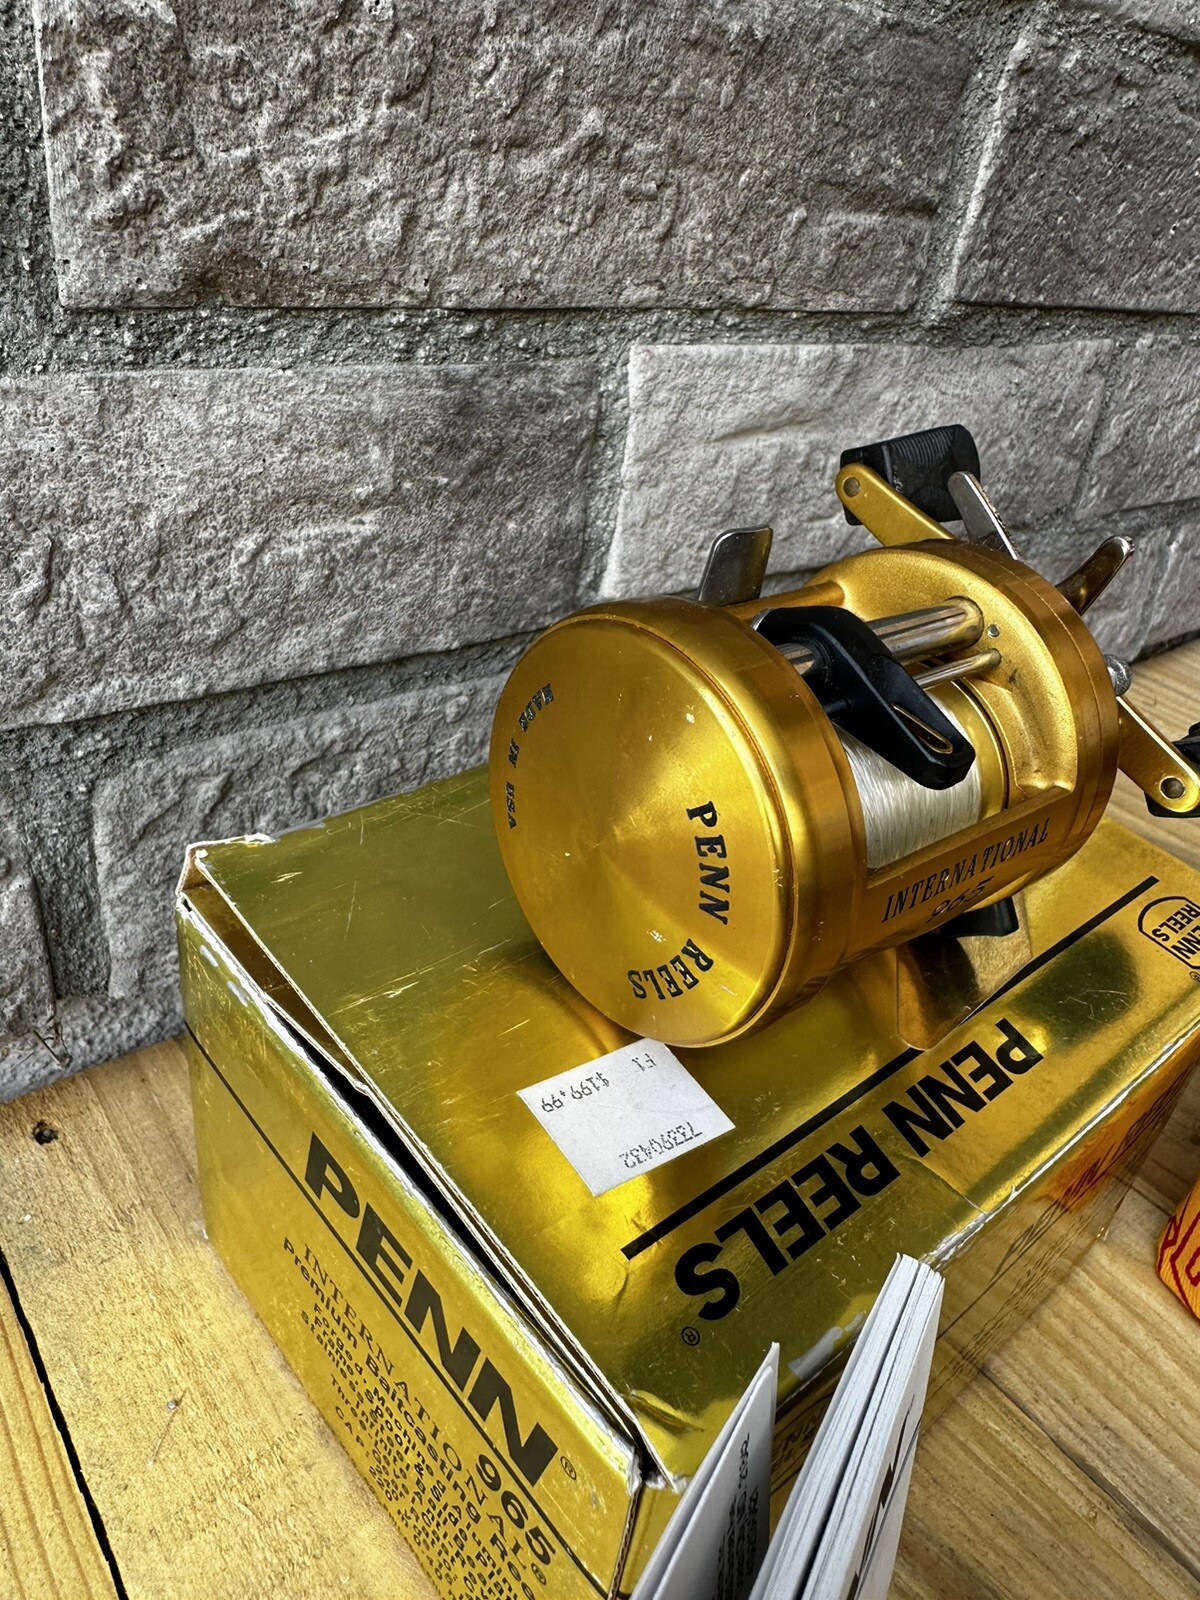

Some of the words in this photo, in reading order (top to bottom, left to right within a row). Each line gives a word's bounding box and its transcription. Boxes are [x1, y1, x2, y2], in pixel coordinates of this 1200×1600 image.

[508, 738, 520, 768] IN
[518, 683, 554, 732] MADE
[505, 781, 517, 829] USA
[686, 801, 730, 925] PENN
[881, 818, 1050, 923] INTERNATIONAL
[627, 938, 714, 1000] REELS
[1151, 904, 1200, 942] REELS
[541, 1071, 610, 1112] $199.99
[632, 1053, 657, 1072] F1
[881, 1017, 1044, 1158] PENN
[674, 1124, 901, 1321] REELS
[304, 1132, 559, 1487] PENN
[283, 1236, 358, 1349] Premium
[365, 1353, 481, 1526] Baitcasting
[300, 1309, 364, 1404] Stainless
[368, 1407, 410, 1472] Steel
[414, 1476, 448, 1527] Ball
[304, 1244, 527, 1570] INTERNATIONAL
[331, 1373, 416, 1505] Three-Level
[420, 1511, 456, 1566] Cast
[355, 1400, 407, 1480] Infinite
[364, 1387, 409, 1455] Spool
[430, 1484, 468, 1542] Side
[368, 1465, 393, 1502] 220
[371, 1448, 405, 1500] Gear
[373, 1386, 446, 1494] Machined
[374, 1464, 399, 1502] 240
[477, 1454, 556, 1566] 965
